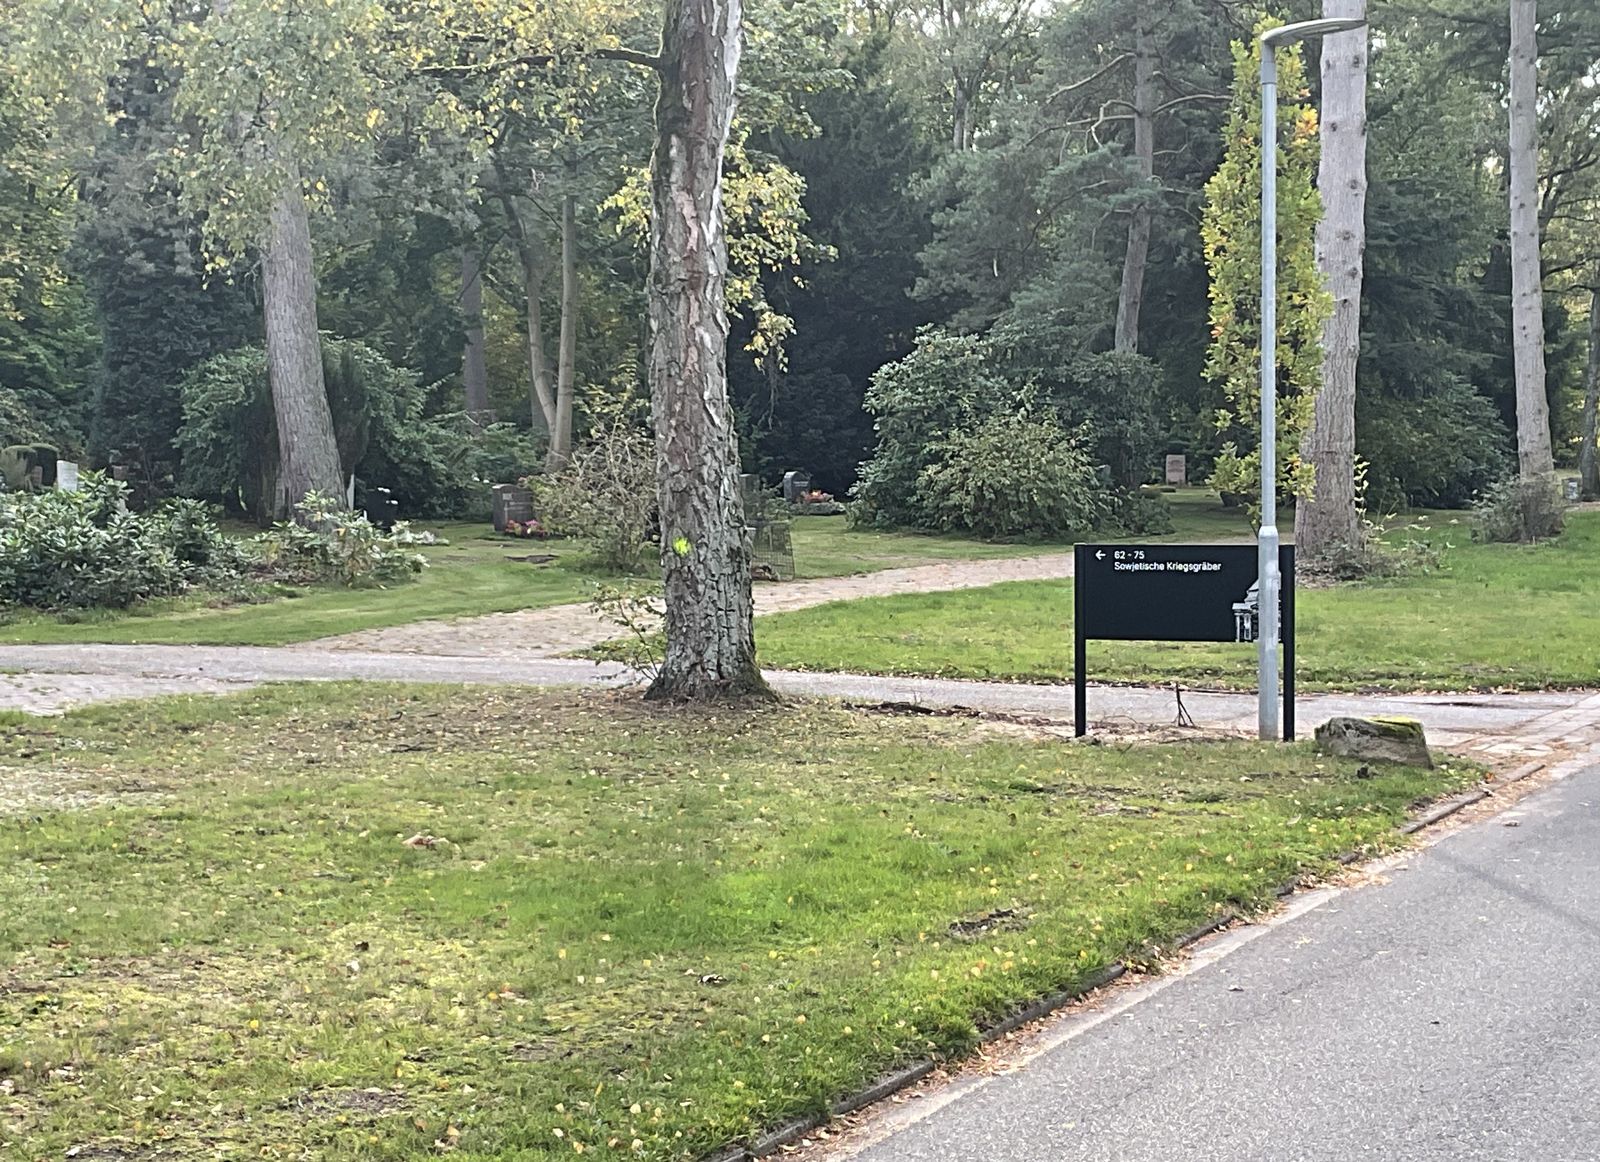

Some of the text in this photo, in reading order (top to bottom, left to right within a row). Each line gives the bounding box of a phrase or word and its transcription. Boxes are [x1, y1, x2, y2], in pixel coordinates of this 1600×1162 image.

[1114, 551, 1126, 559] 62
[1134, 551, 1145, 559] 75
[1114, 562, 1222, 573] Sowjetische Kriegsgräber
